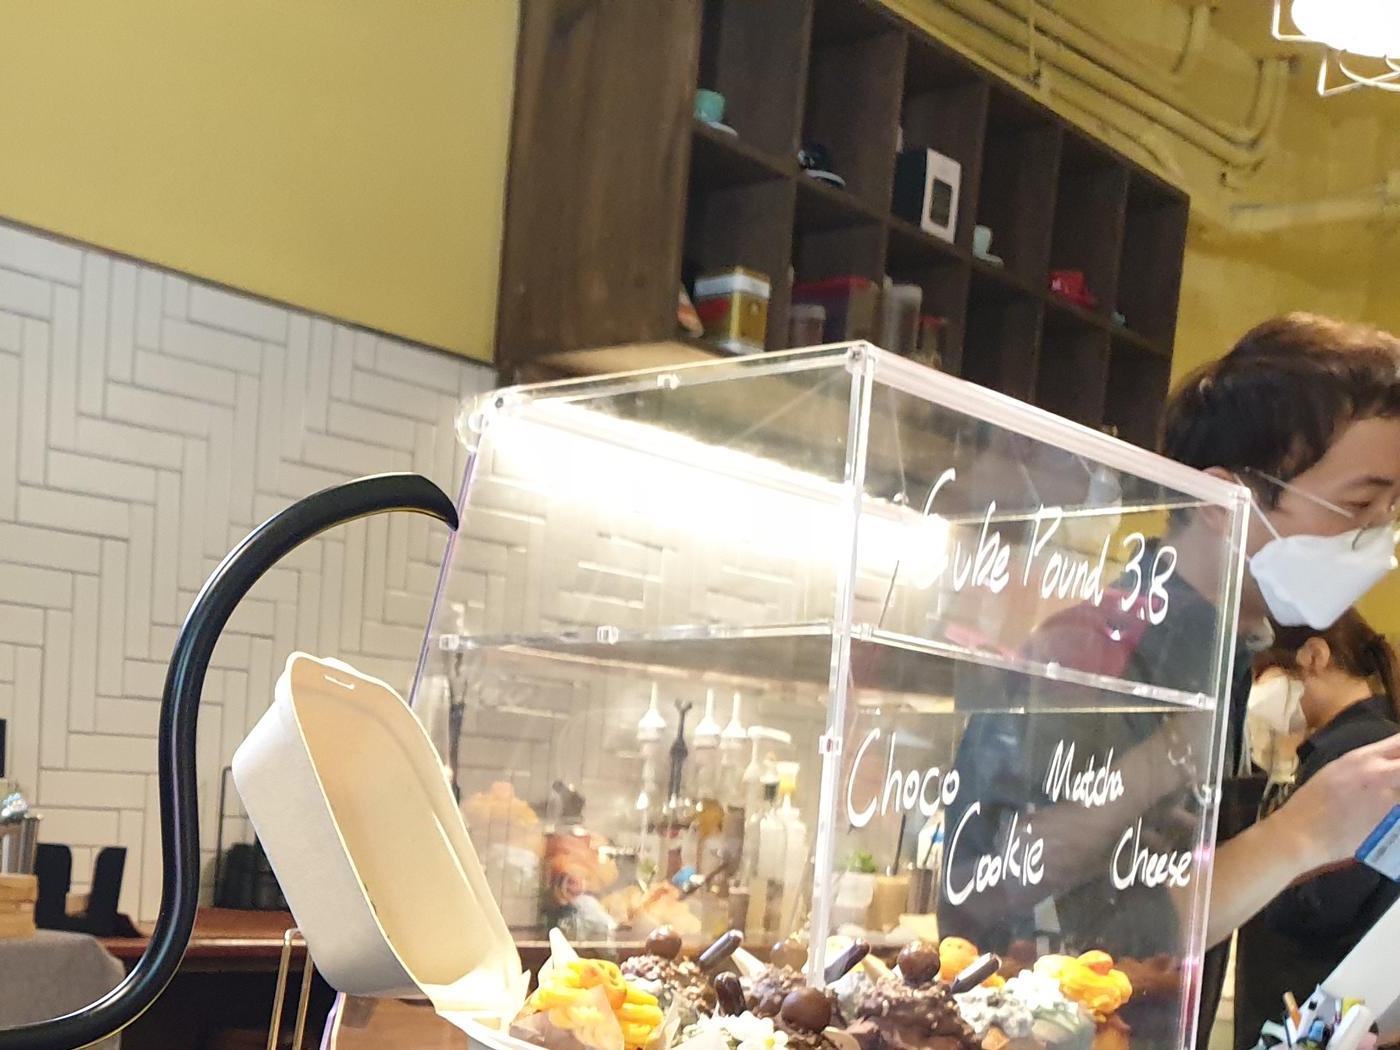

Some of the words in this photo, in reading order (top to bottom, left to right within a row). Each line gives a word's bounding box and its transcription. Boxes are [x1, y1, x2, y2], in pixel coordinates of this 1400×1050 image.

[1023, 503, 1111, 606] Pound
[1119, 532, 1178, 625] 3.8
[846, 728, 960, 827] Choco
[1045, 739, 1124, 808] Matcha
[946, 802, 1045, 905] Cookie
[1112, 817, 1191, 890] Cheese
